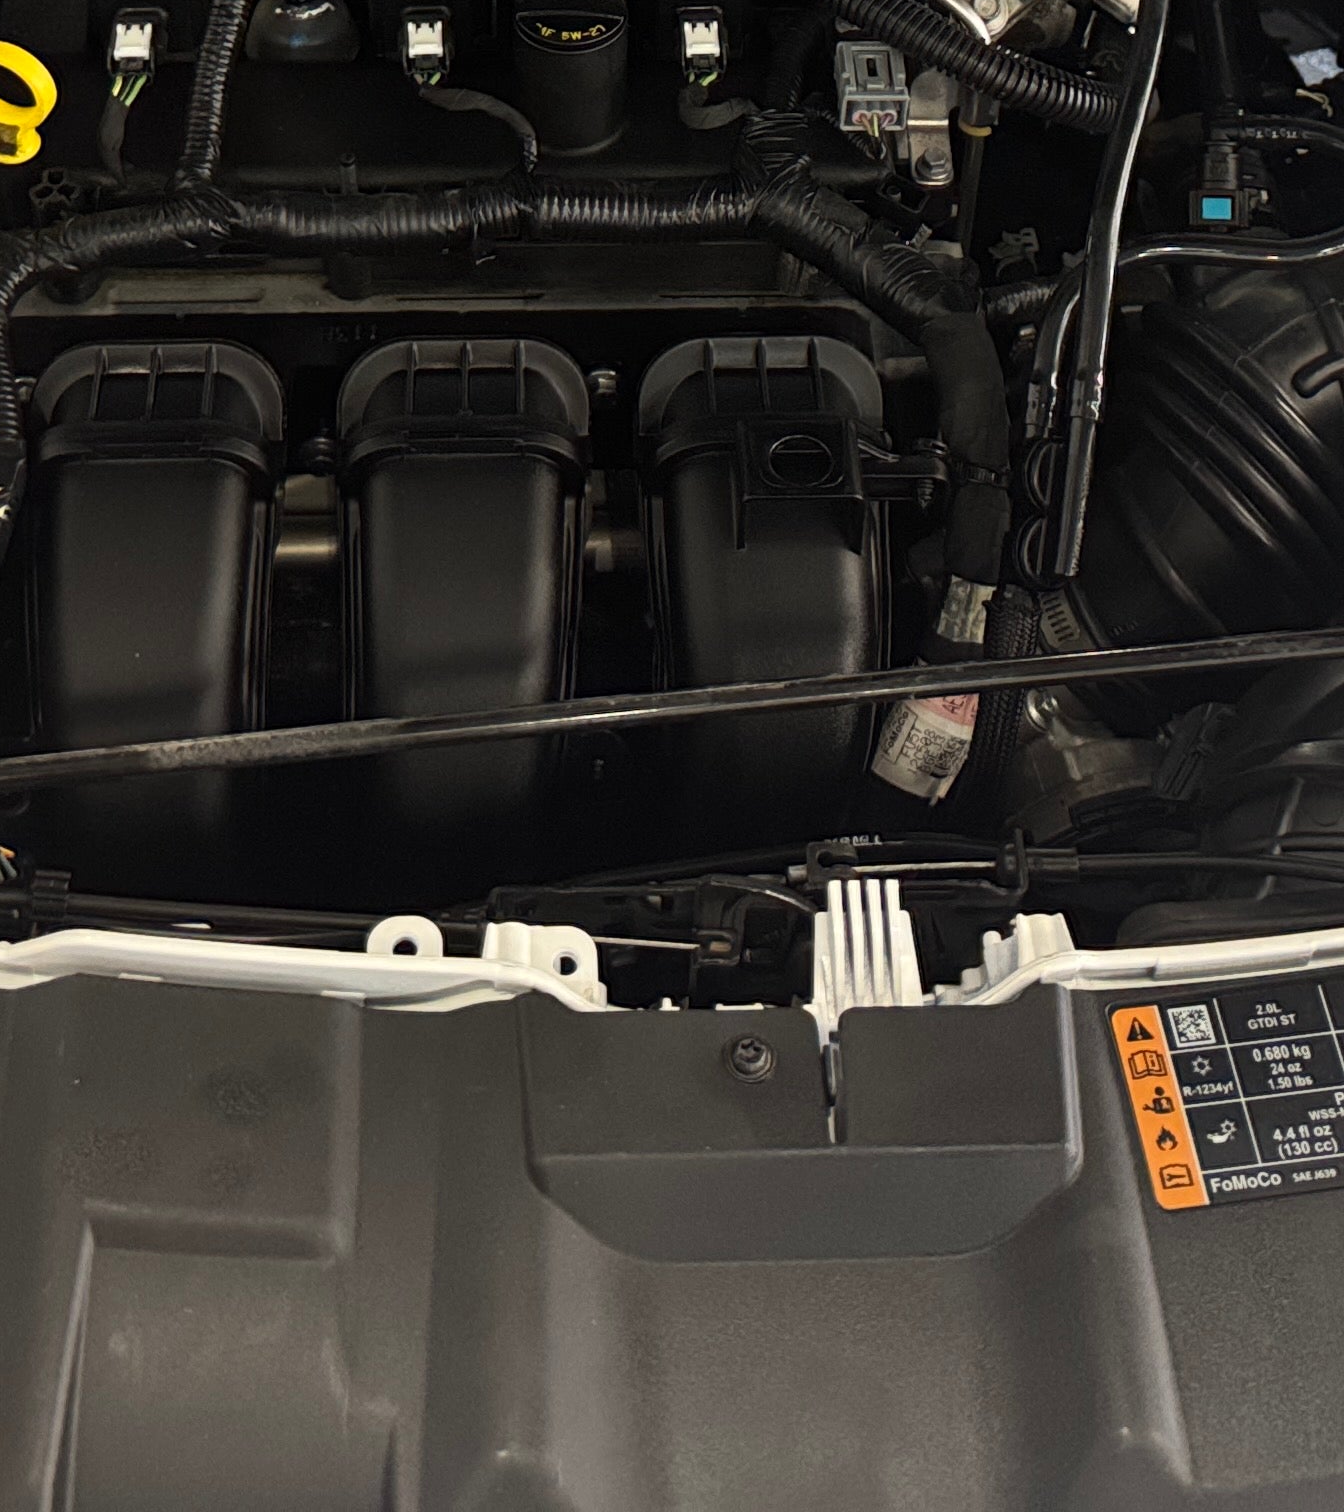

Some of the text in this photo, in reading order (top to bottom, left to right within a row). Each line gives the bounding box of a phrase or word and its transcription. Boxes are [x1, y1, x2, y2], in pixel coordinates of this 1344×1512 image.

[882, 711, 908, 756] FoMoCo
[1256, 1003, 1282, 1016] 2.0L
[1247, 1013, 1296, 1030] GTDI ST
[1252, 1043, 1311, 1063] 0.680 kg
[1270, 1062, 1302, 1075] 24 oz
[1182, 1081, 1234, 1097] R-1234yf
[1267, 1075, 1313, 1091] 1.50 lbs
[1272, 1124, 1333, 1141] 4.4 fl oz
[1278, 1137, 1339, 1160] (130 cc)
[1210, 1172, 1282, 1193] FoMoCo
[1292, 1171, 1313, 1183] SAE
[1314, 1168, 1337, 1180] J639
